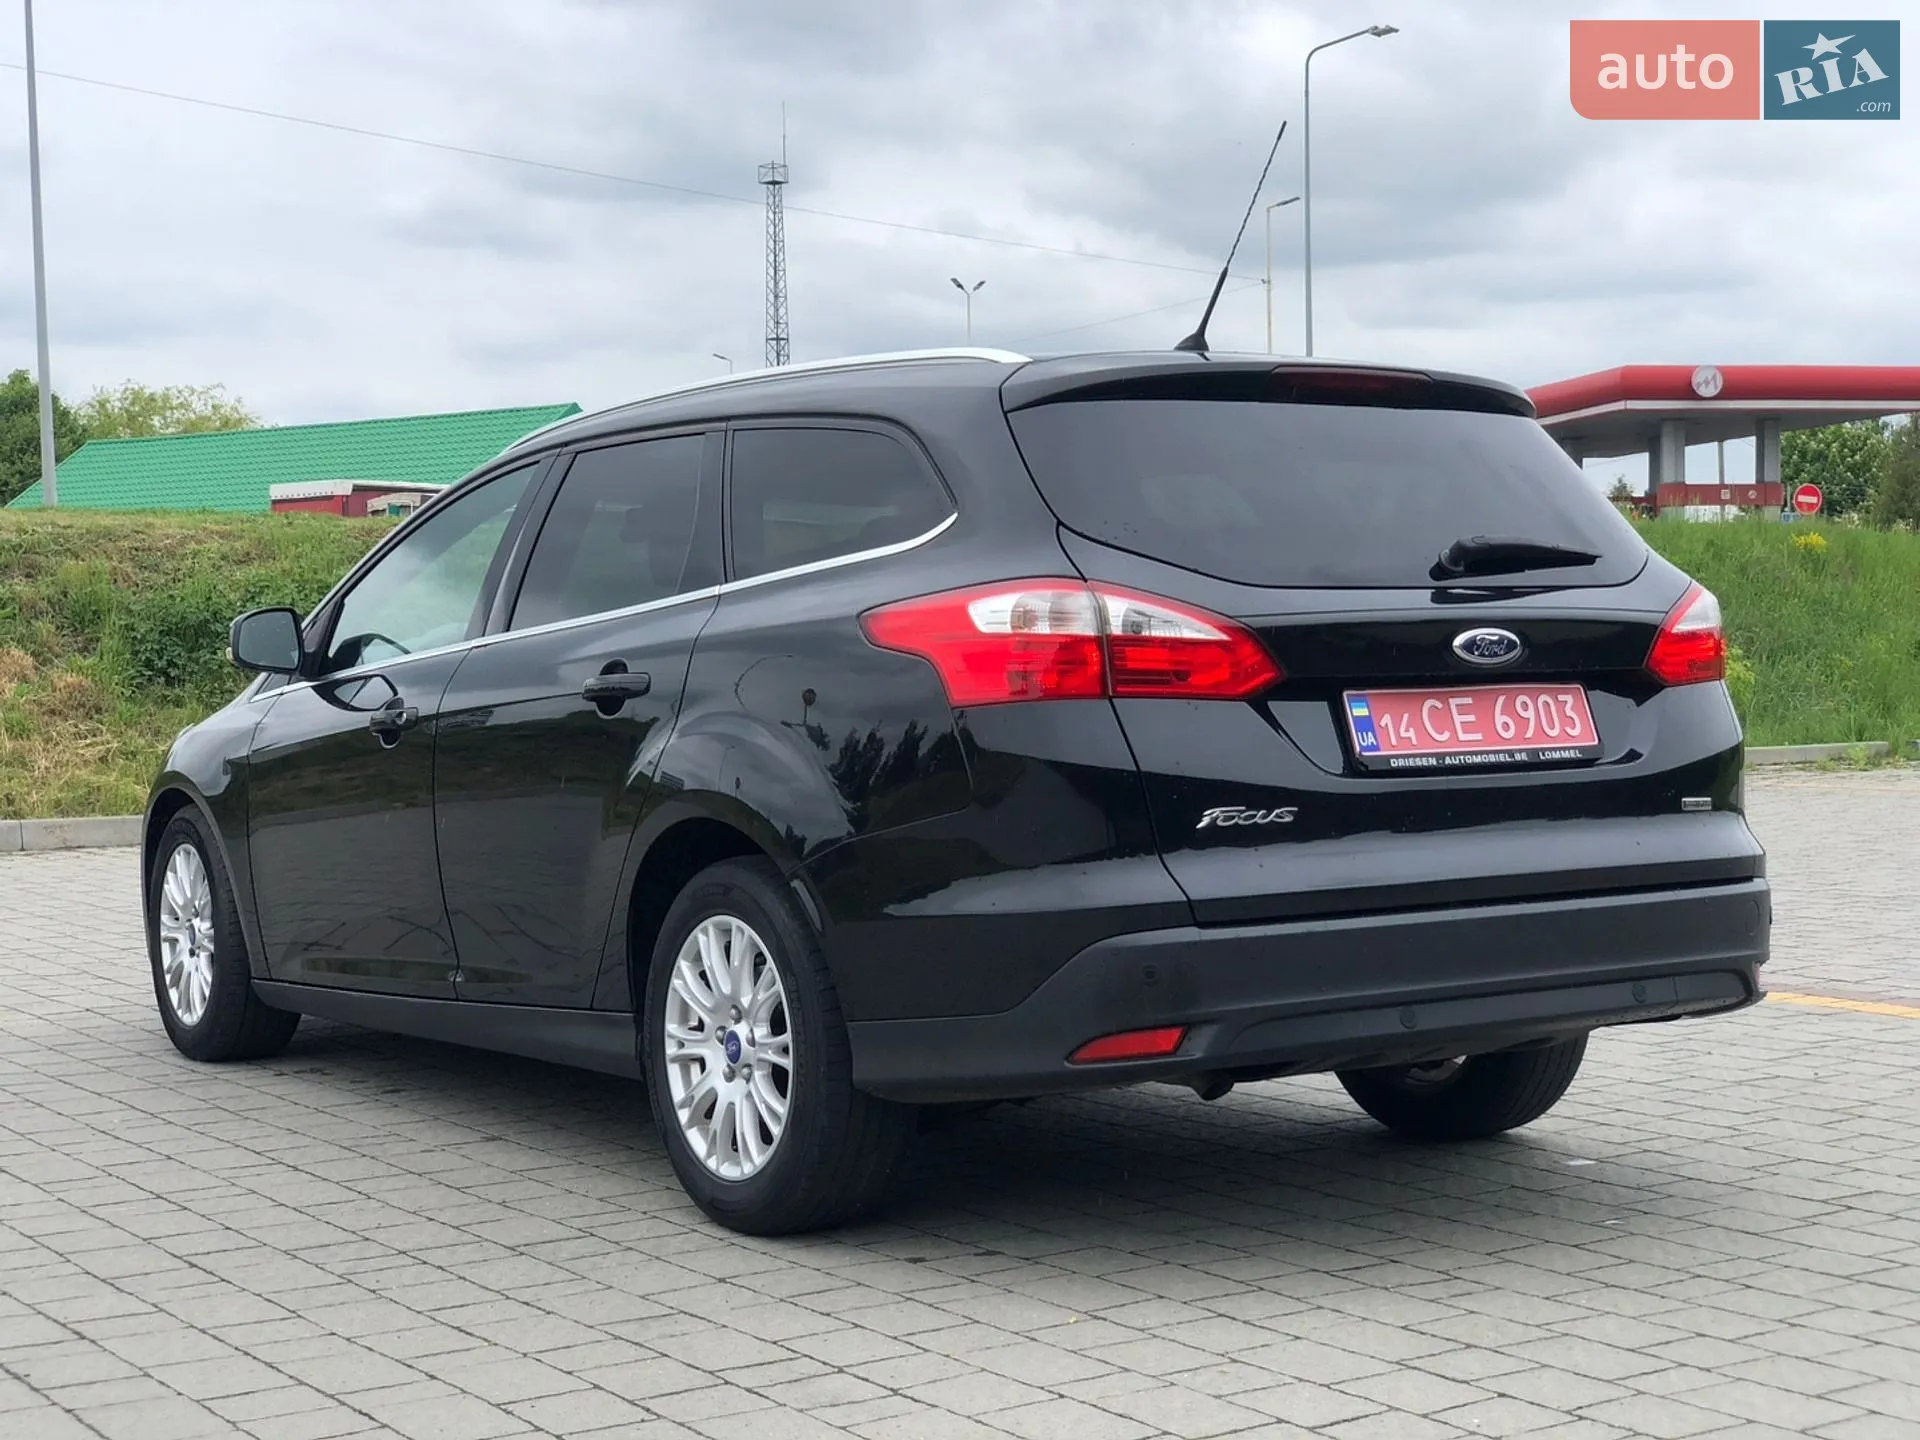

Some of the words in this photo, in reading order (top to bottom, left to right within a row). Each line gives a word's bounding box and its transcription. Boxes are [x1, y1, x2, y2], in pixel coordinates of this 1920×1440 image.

[1473, 634, 1508, 655] Ford
[1378, 712, 1417, 746] 14
[1420, 696, 1483, 742] CE
[1494, 694, 1582, 740] 6903
[1358, 732, 1377, 747] UA
[1538, 749, 1582, 760] LOMMEL
